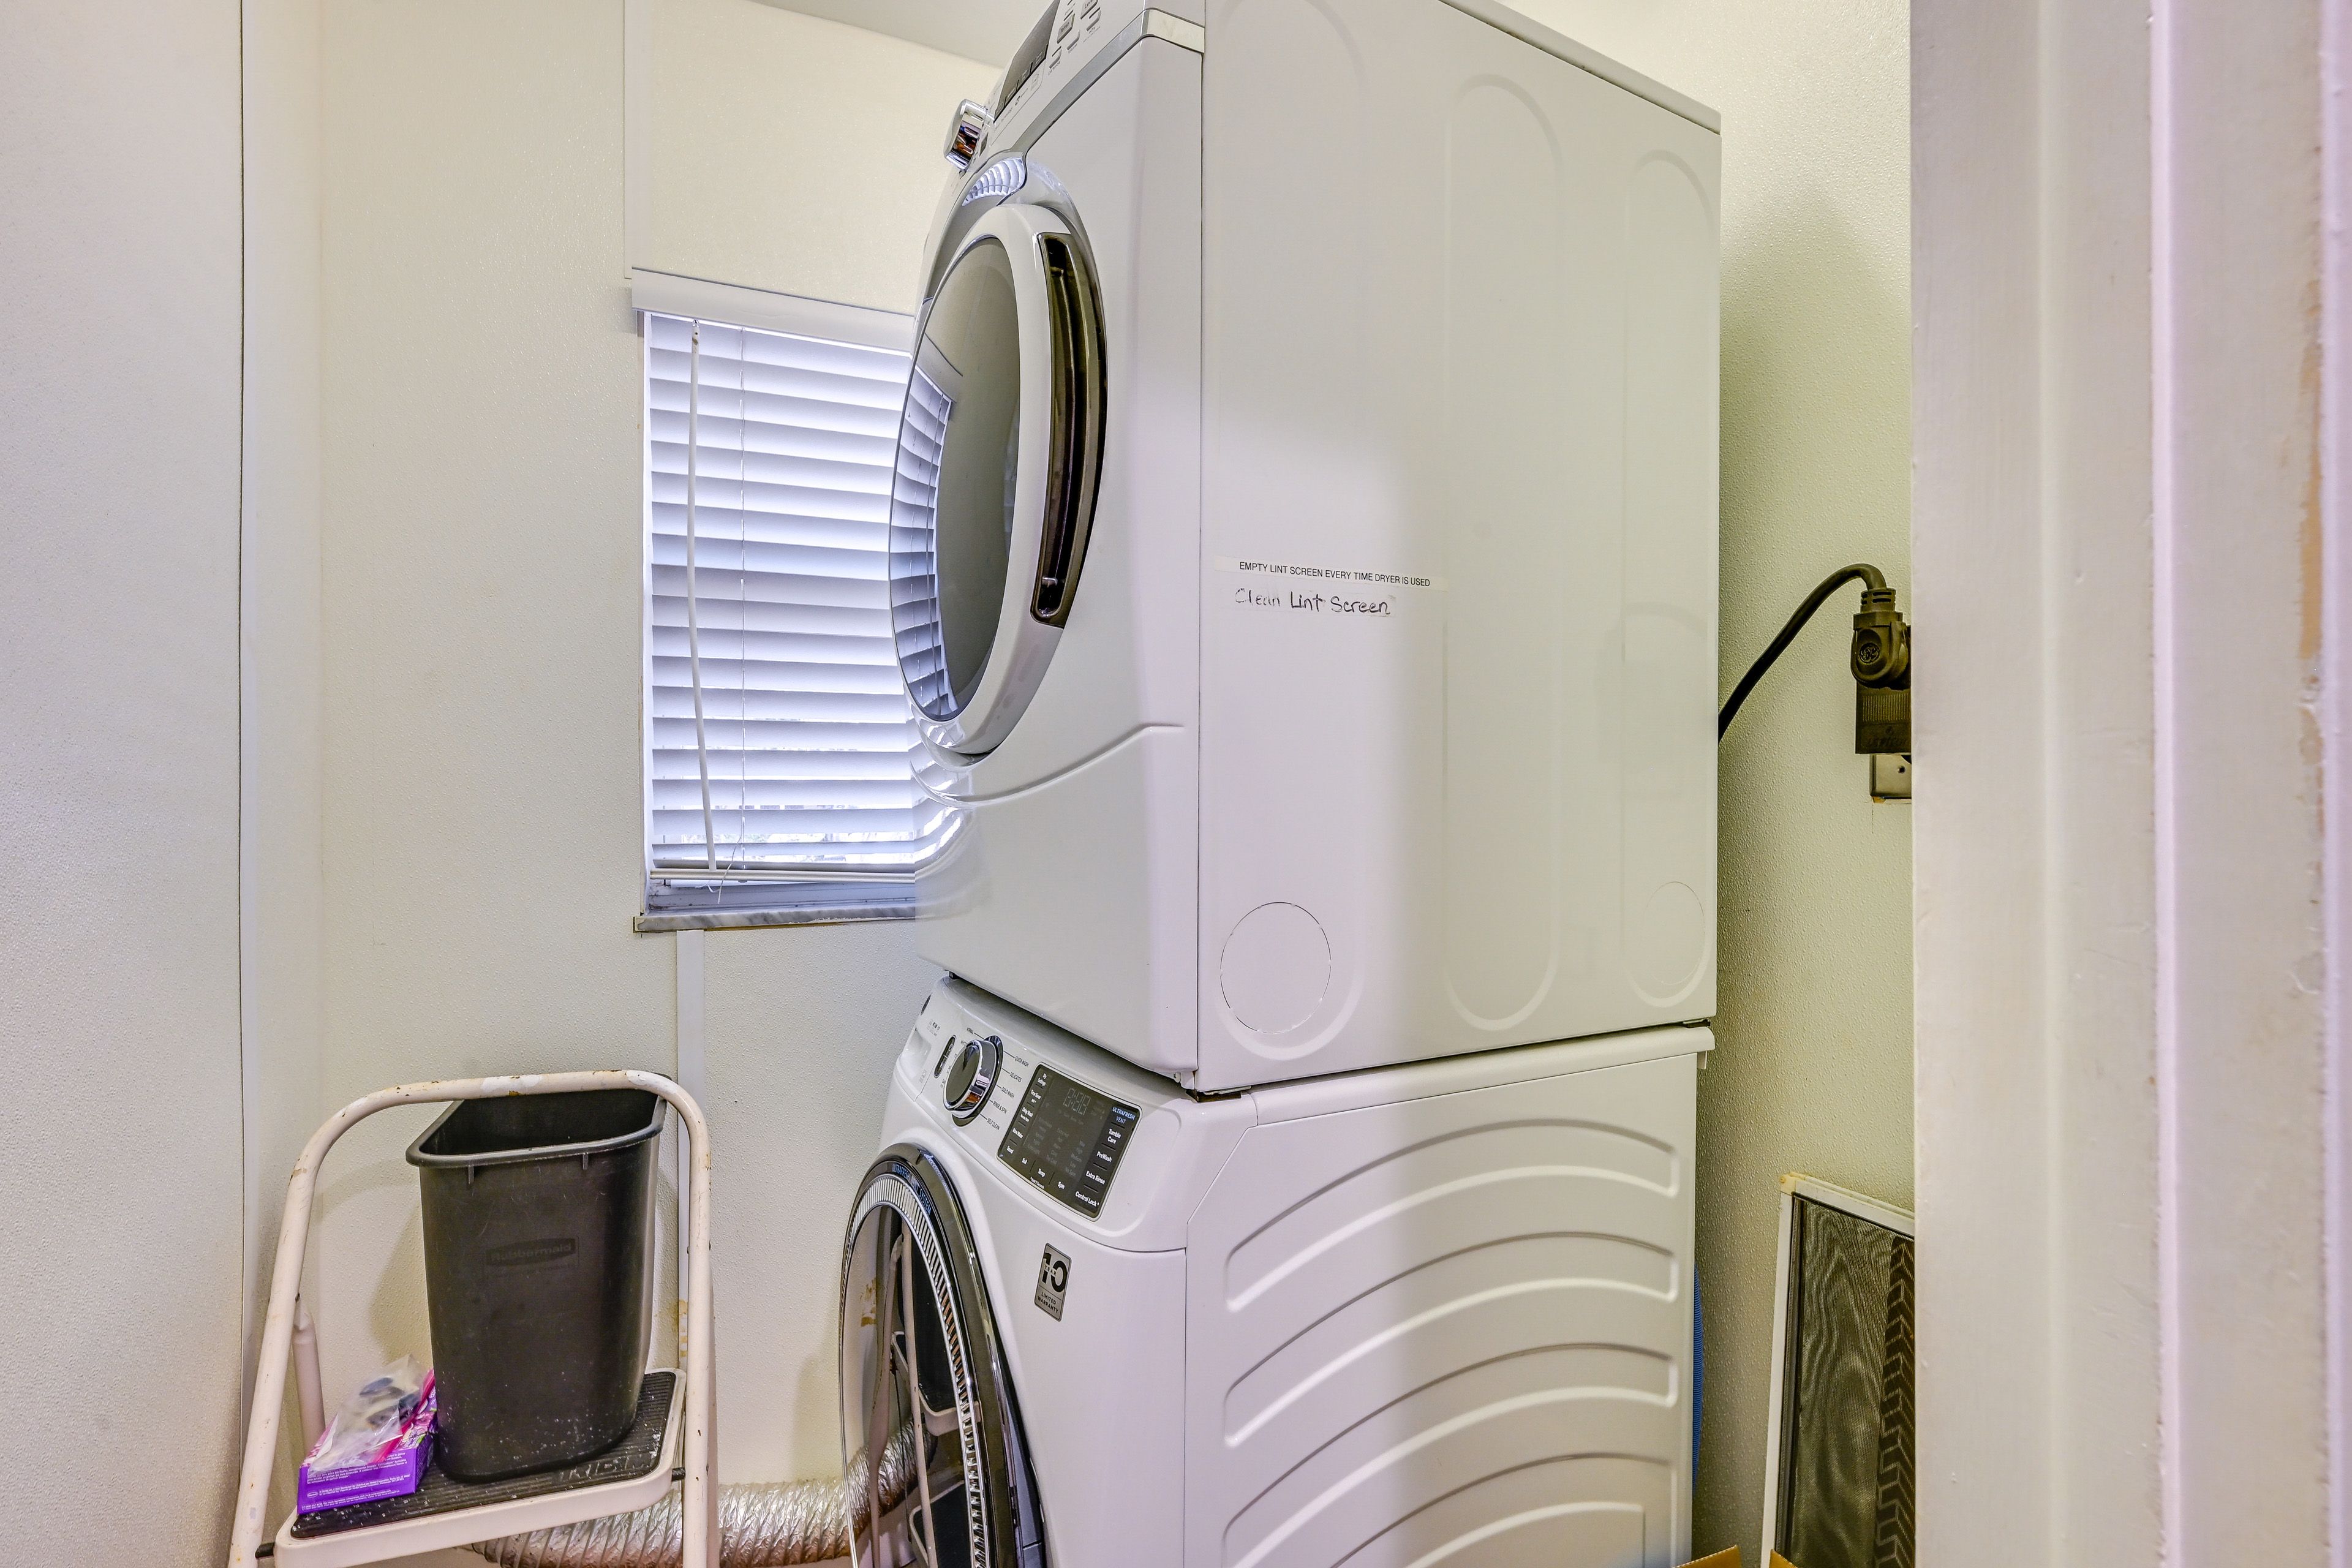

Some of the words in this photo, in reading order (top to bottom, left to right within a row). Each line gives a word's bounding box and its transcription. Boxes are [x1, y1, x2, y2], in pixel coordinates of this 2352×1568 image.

[1240, 562, 1267, 571] EMPTY
[1270, 565, 1287, 573] LINT
[1290, 567, 1323, 577] SCREEN
[1325, 570, 1351, 579] EVERY
[1354, 572, 1373, 581] TIME
[1375, 574, 1400, 583] DRYER
[1235, 588, 1280, 606] Clean
[1291, 591, 1325, 612] Lint
[1330, 596, 1390, 615] Screen
[1009, 1072, 1022, 1082] DELICATES
[1112, 1106, 1135, 1120] ULTRAFRESH
[1116, 1115, 1126, 1124] VENT
[1108, 1128, 1121, 1139] Tumble
[1096, 1151, 1112, 1163] PreWash
[1086, 1170, 1096, 1180] Extra
[1095, 1175, 1106, 1185] Rinse
[919, 1188, 932, 1215] SYSTEM
[1075, 1191, 1089, 1203] Control
[1088, 1197, 1097, 1207] Lock
[1042, 1253, 1068, 1292] 10
[1044, 1264, 1057, 1276] YEAR
[1038, 1296, 1058, 1313] WARRANTY
[1041, 1292, 1057, 1305] LIMITED
